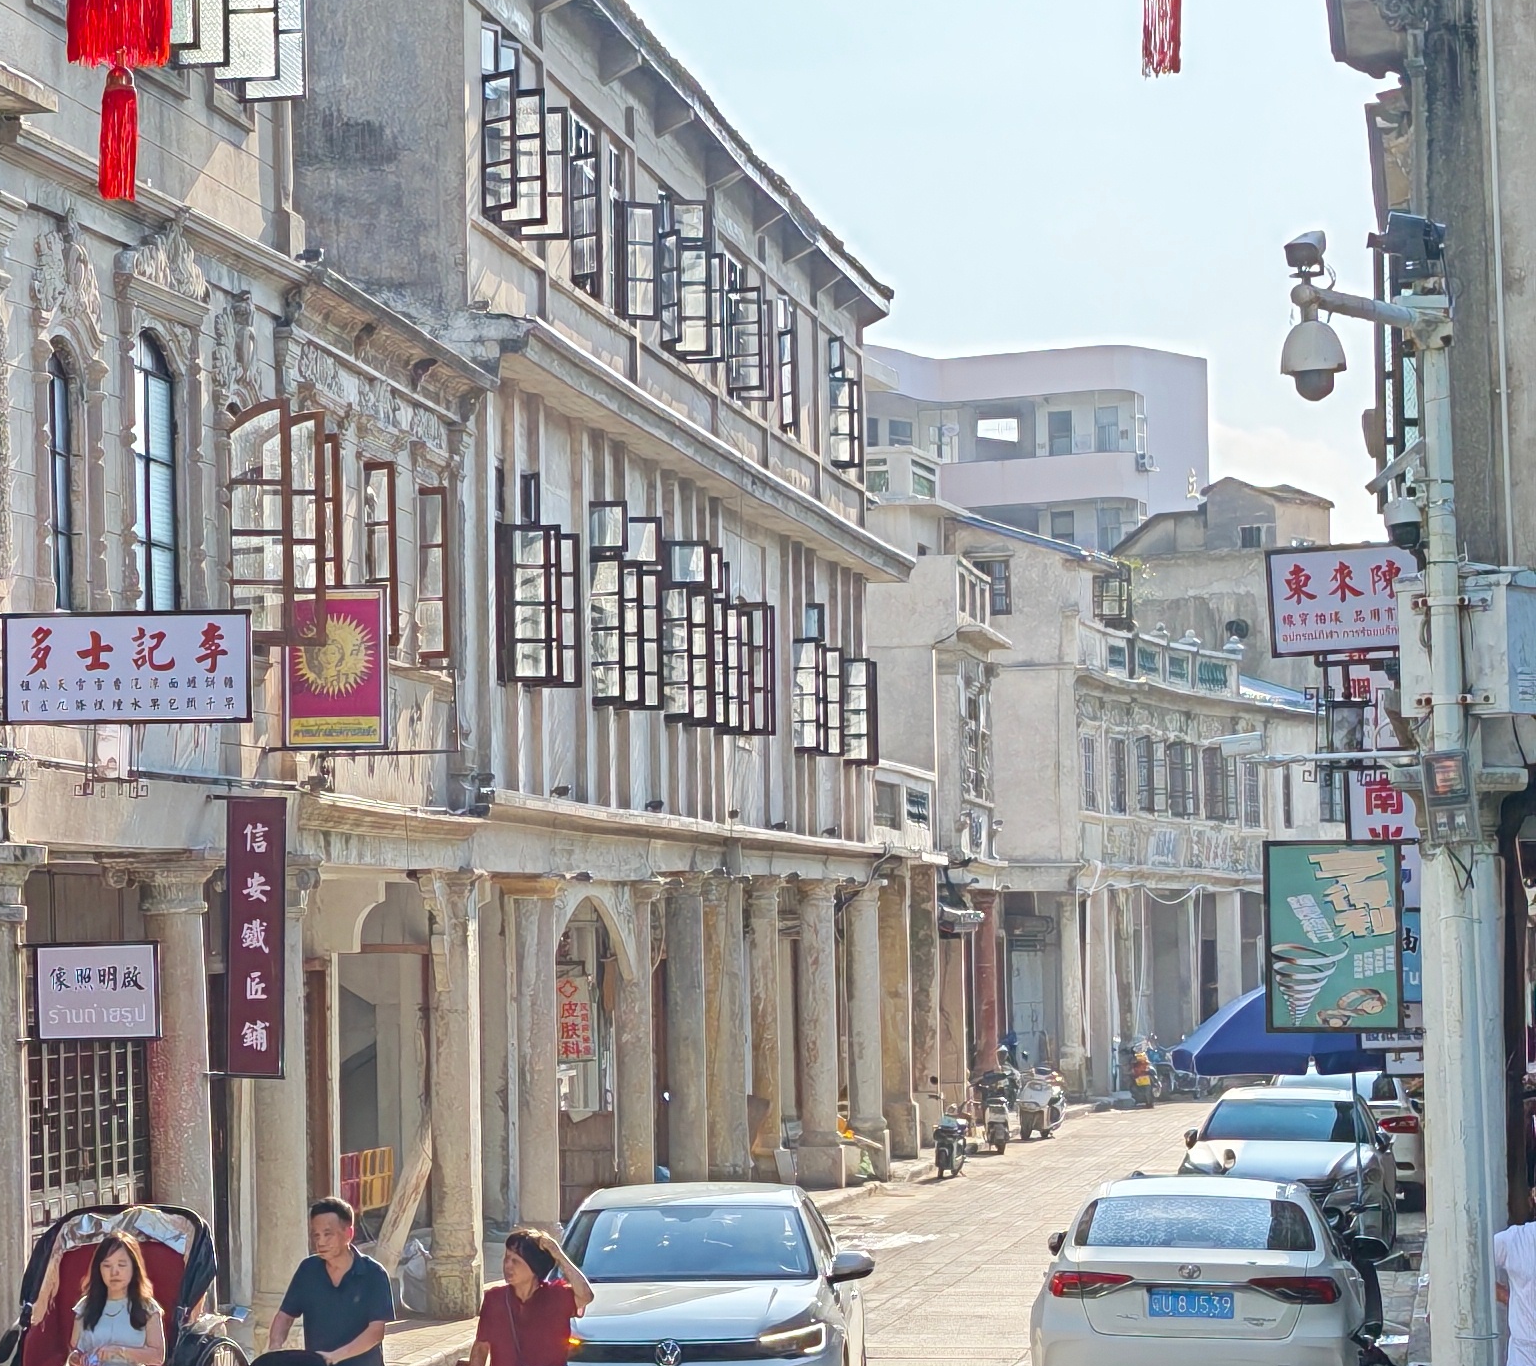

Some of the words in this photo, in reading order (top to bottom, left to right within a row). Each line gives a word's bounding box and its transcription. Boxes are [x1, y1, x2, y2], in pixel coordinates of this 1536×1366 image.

[240, 823, 272, 1053] 信安鐵匠鋪
